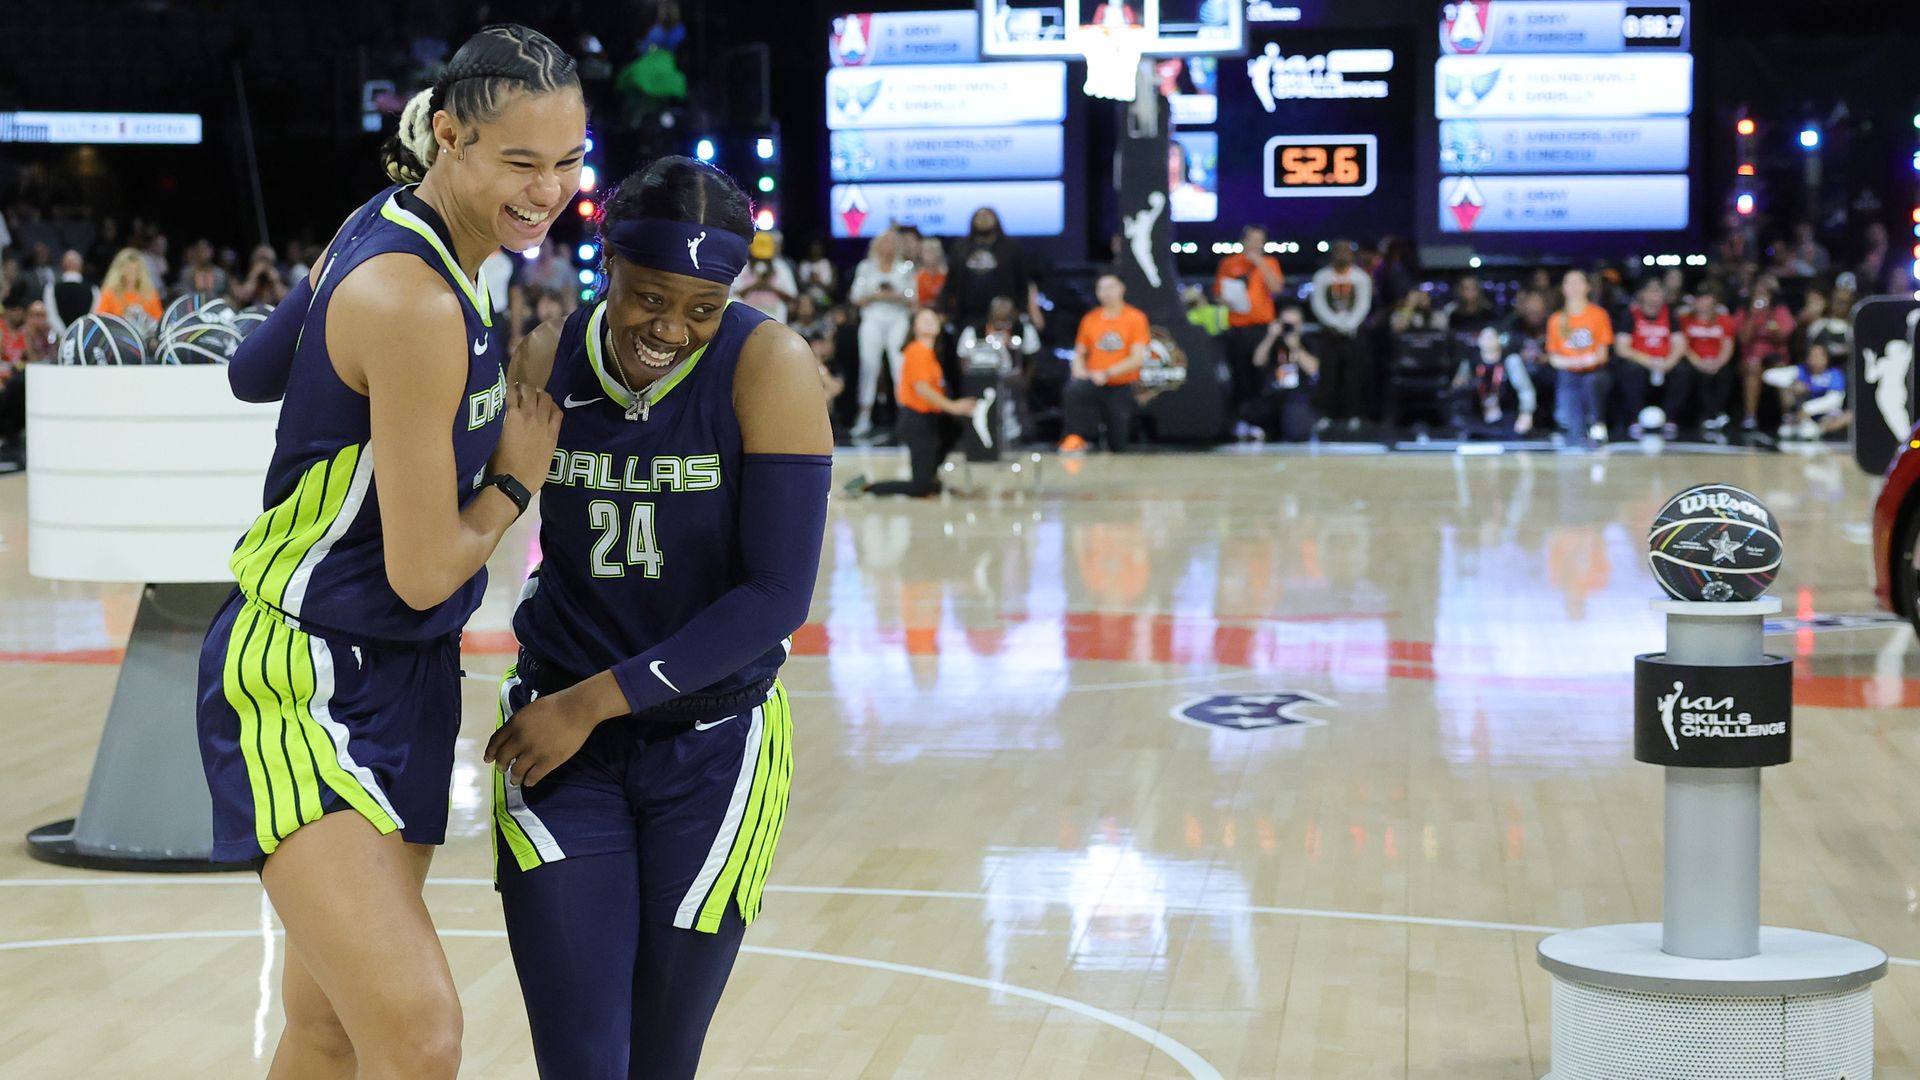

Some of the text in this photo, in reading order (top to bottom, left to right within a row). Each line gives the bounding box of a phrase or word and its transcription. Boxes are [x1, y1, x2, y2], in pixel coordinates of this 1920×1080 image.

[1281, 146, 1360, 185] 52.6
[624, 400, 650, 421] 24
[546, 448, 721, 492] DALLAS
[1678, 491, 1769, 525] Wilson
[588, 499, 663, 579] 24
[1680, 696, 1734, 711] KIA
[1680, 712, 1752, 726] SKILLS
[1680, 721, 1786, 738] CHALLENGE
